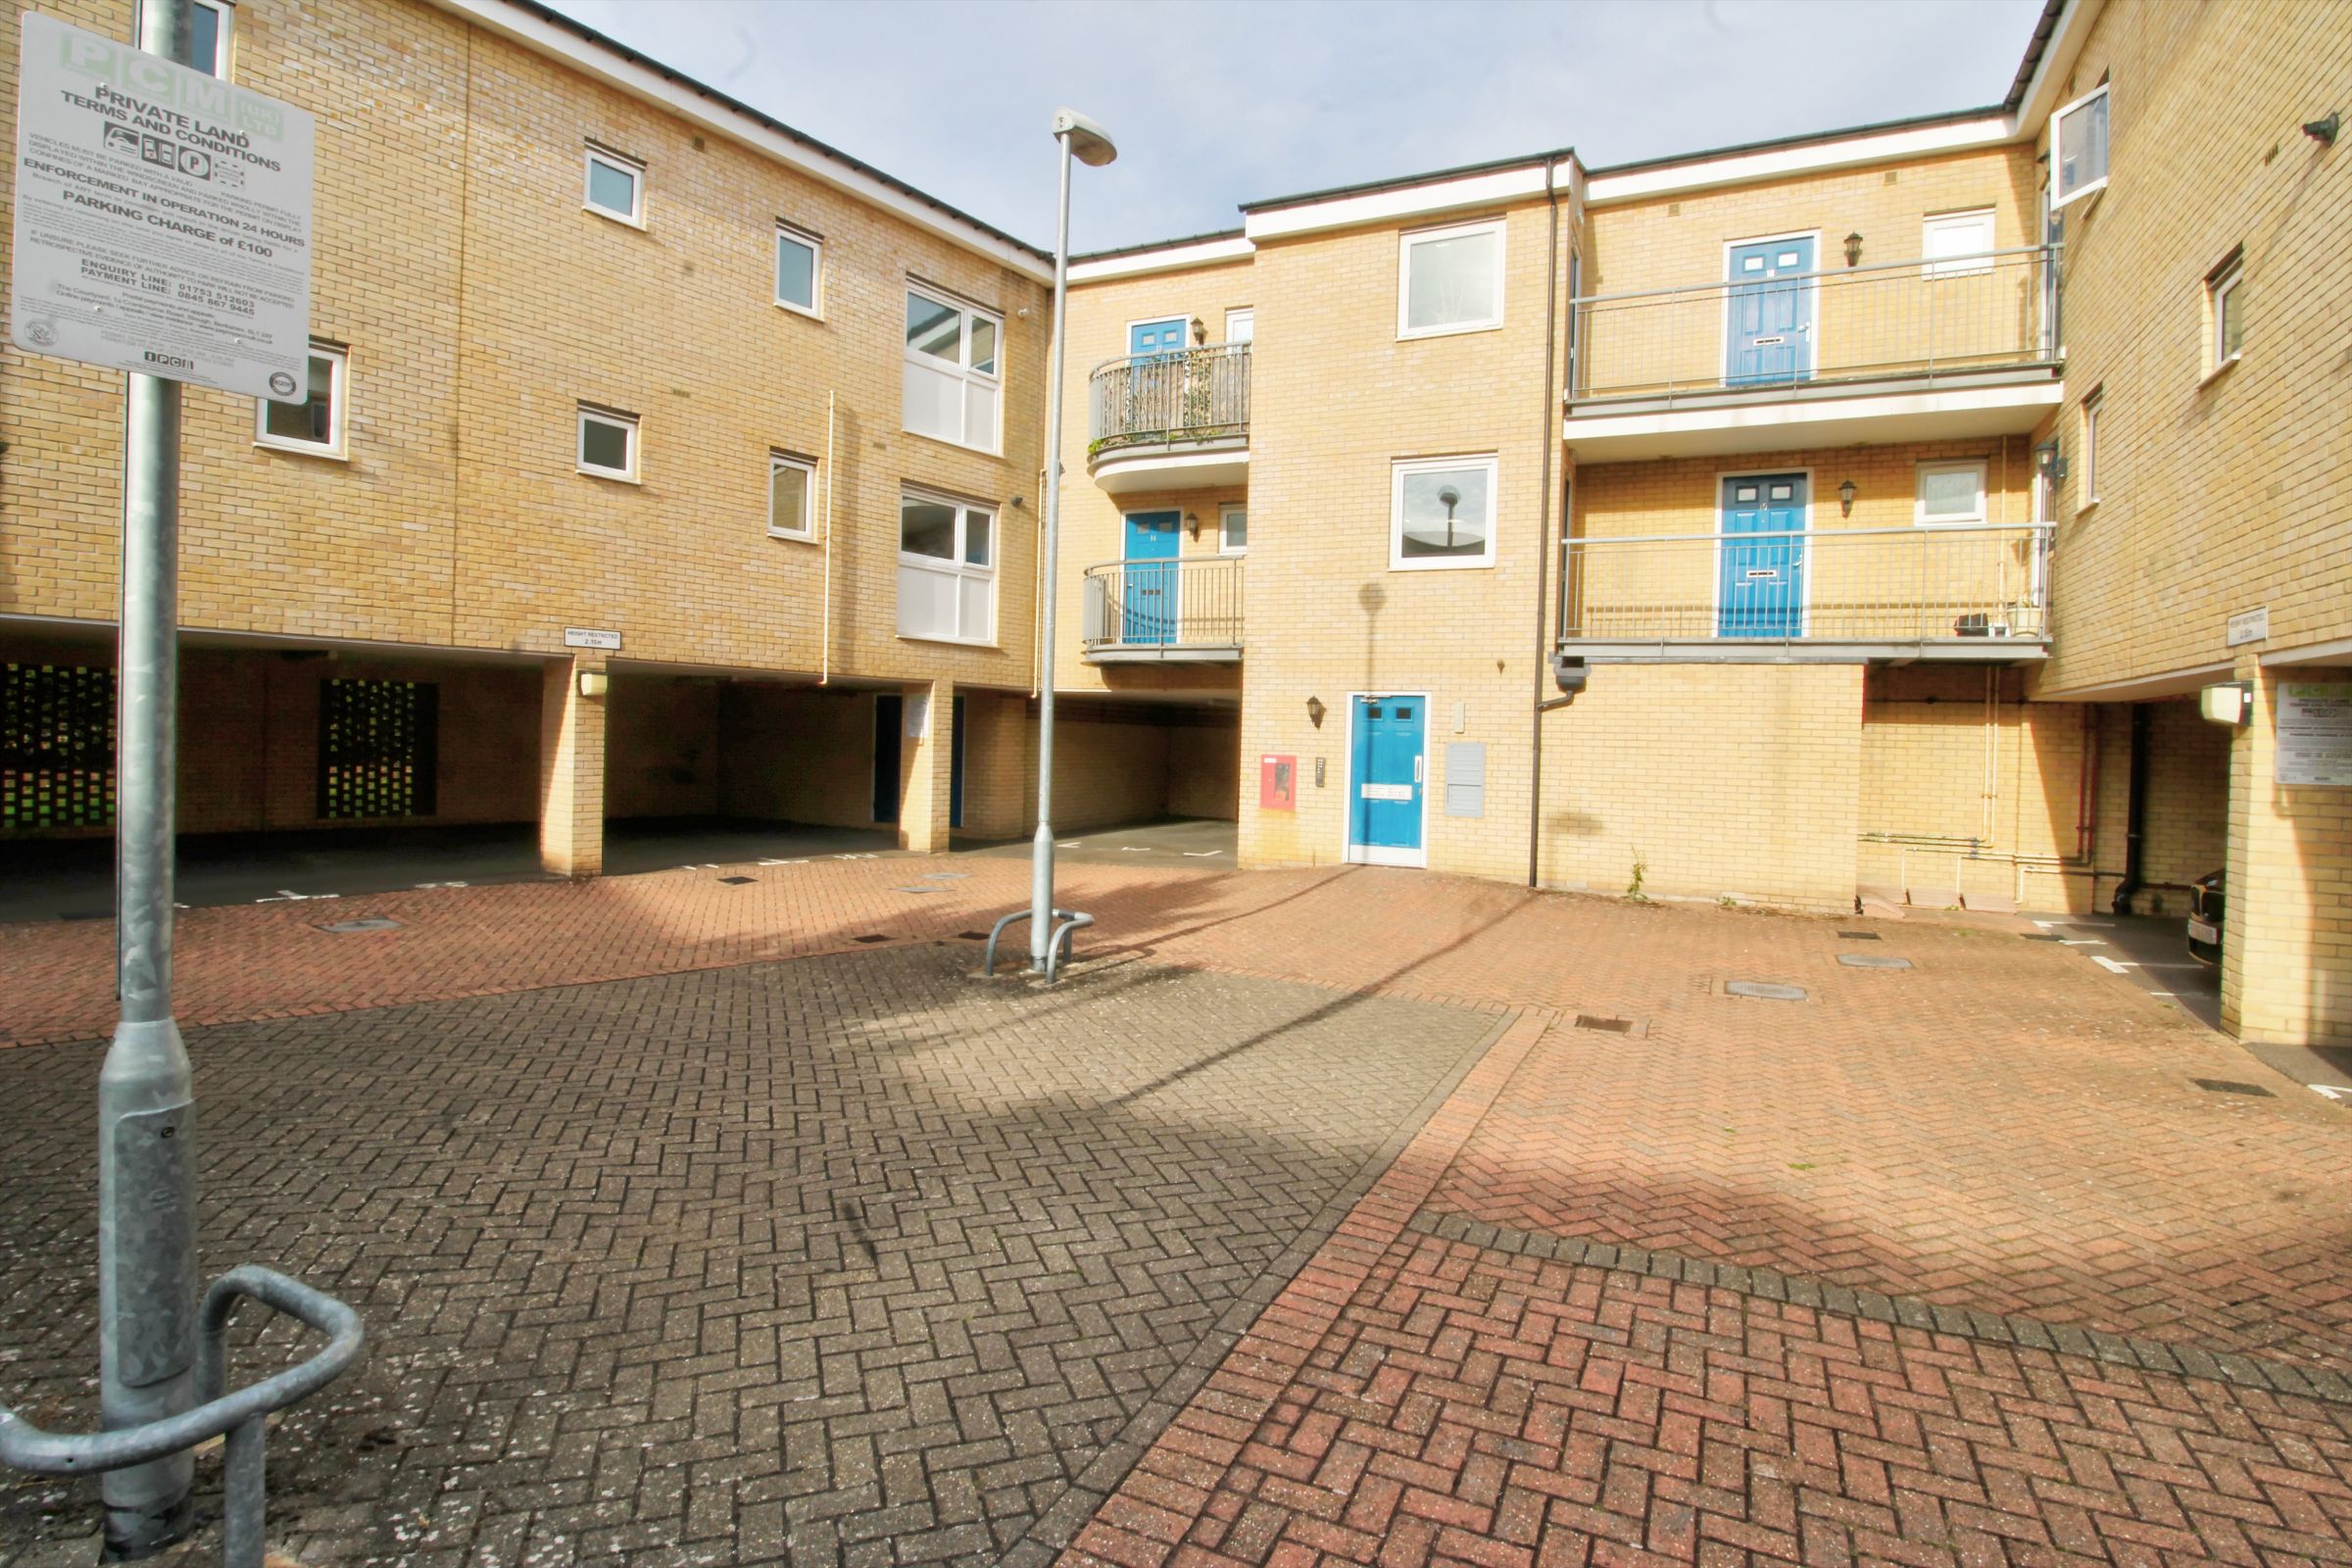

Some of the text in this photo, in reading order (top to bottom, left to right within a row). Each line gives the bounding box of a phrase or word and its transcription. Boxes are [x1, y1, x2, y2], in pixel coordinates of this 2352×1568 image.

[70, 34, 225, 115] PCM
[61, 90, 280, 172] TERMS AND CONDITIONS
[94, 87, 250, 149] PRIVATE LAND
[242, 115, 276, 136] LTD
[29, 132, 70, 149] VEHICLES
[72, 145, 94, 156] MUST
[109, 157, 141, 171] PARKED
[23, 158, 305, 247] ENFORCEMENT IN OPERATION 24 HOURS
[63, 190, 271, 257] PARKING CHARGE of £100
[80, 266, 136, 286] PAYMENT
[177, 290, 203, 303] 0845
[207, 297, 226, 309] 867
[229, 303, 254, 316] 9445
[81, 258, 136, 278] ENQUIRY
[178, 282, 212, 297] 01753
[216, 292, 254, 308] 512603
